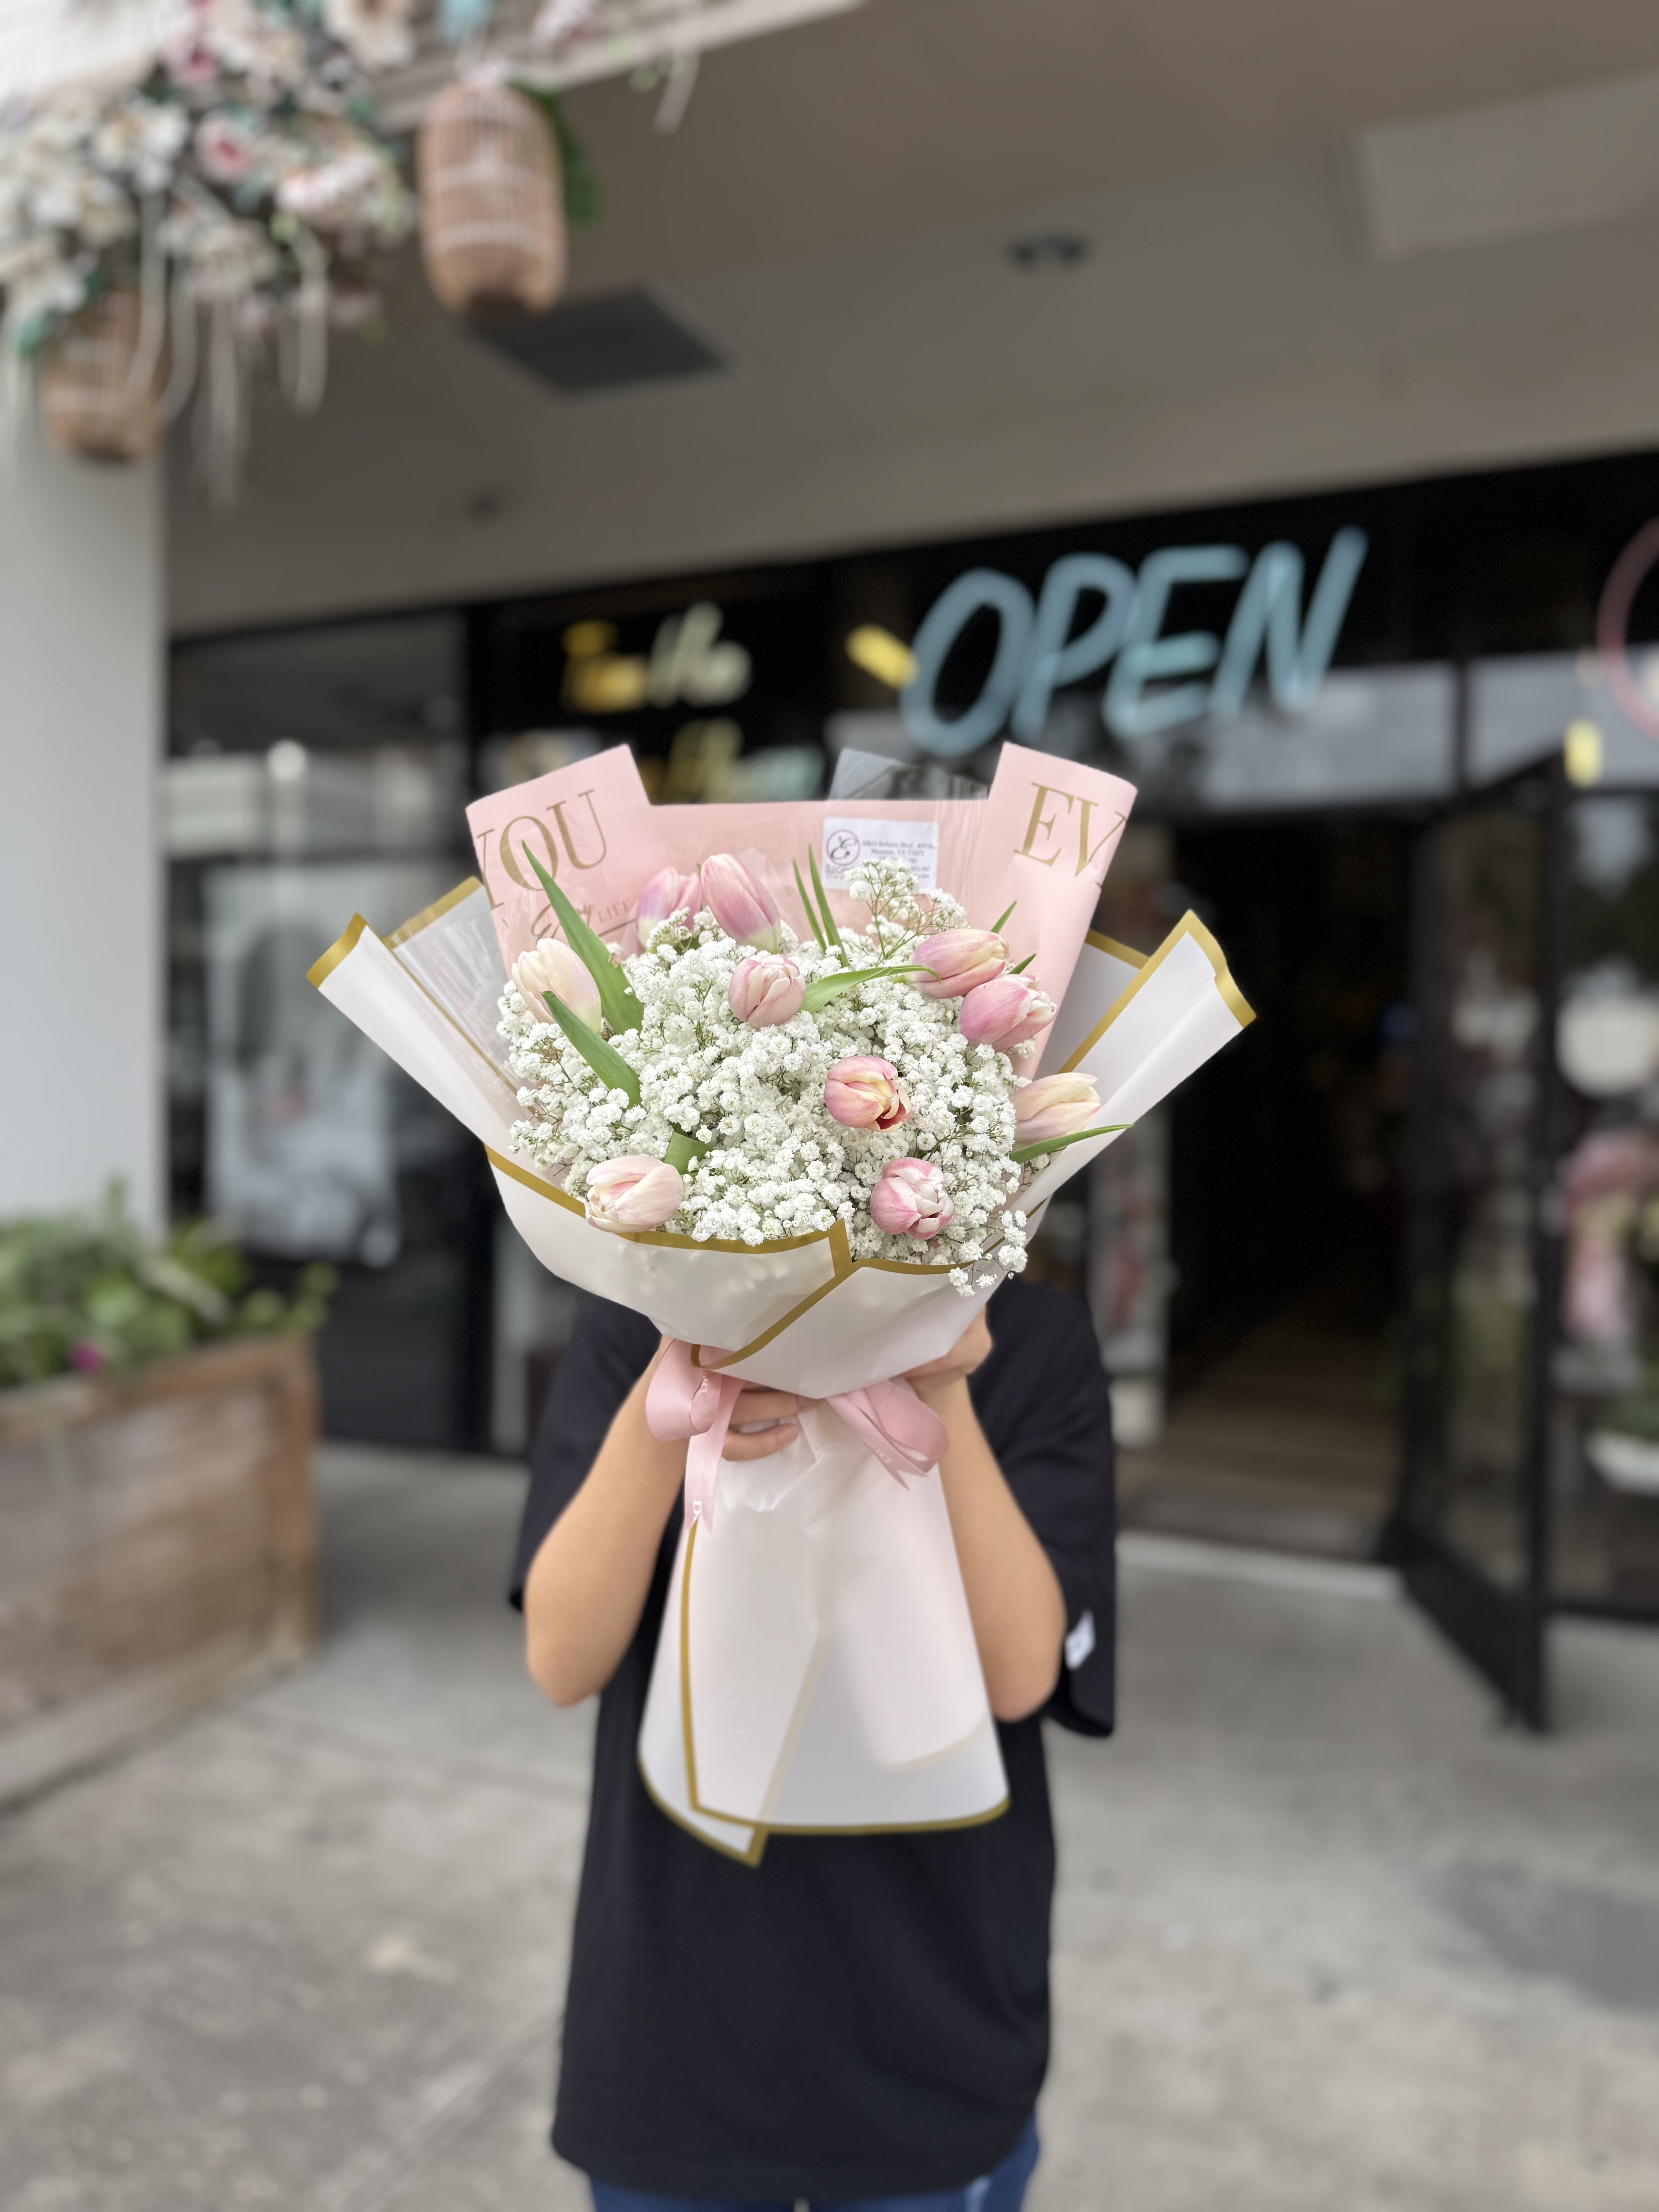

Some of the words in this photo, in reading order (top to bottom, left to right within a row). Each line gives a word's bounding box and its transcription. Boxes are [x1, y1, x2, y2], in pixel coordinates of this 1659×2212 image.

[899, 526, 1367, 757] OPEN
[1013, 781, 1128, 888] EV
[598, 899, 631, 924] LIFE
